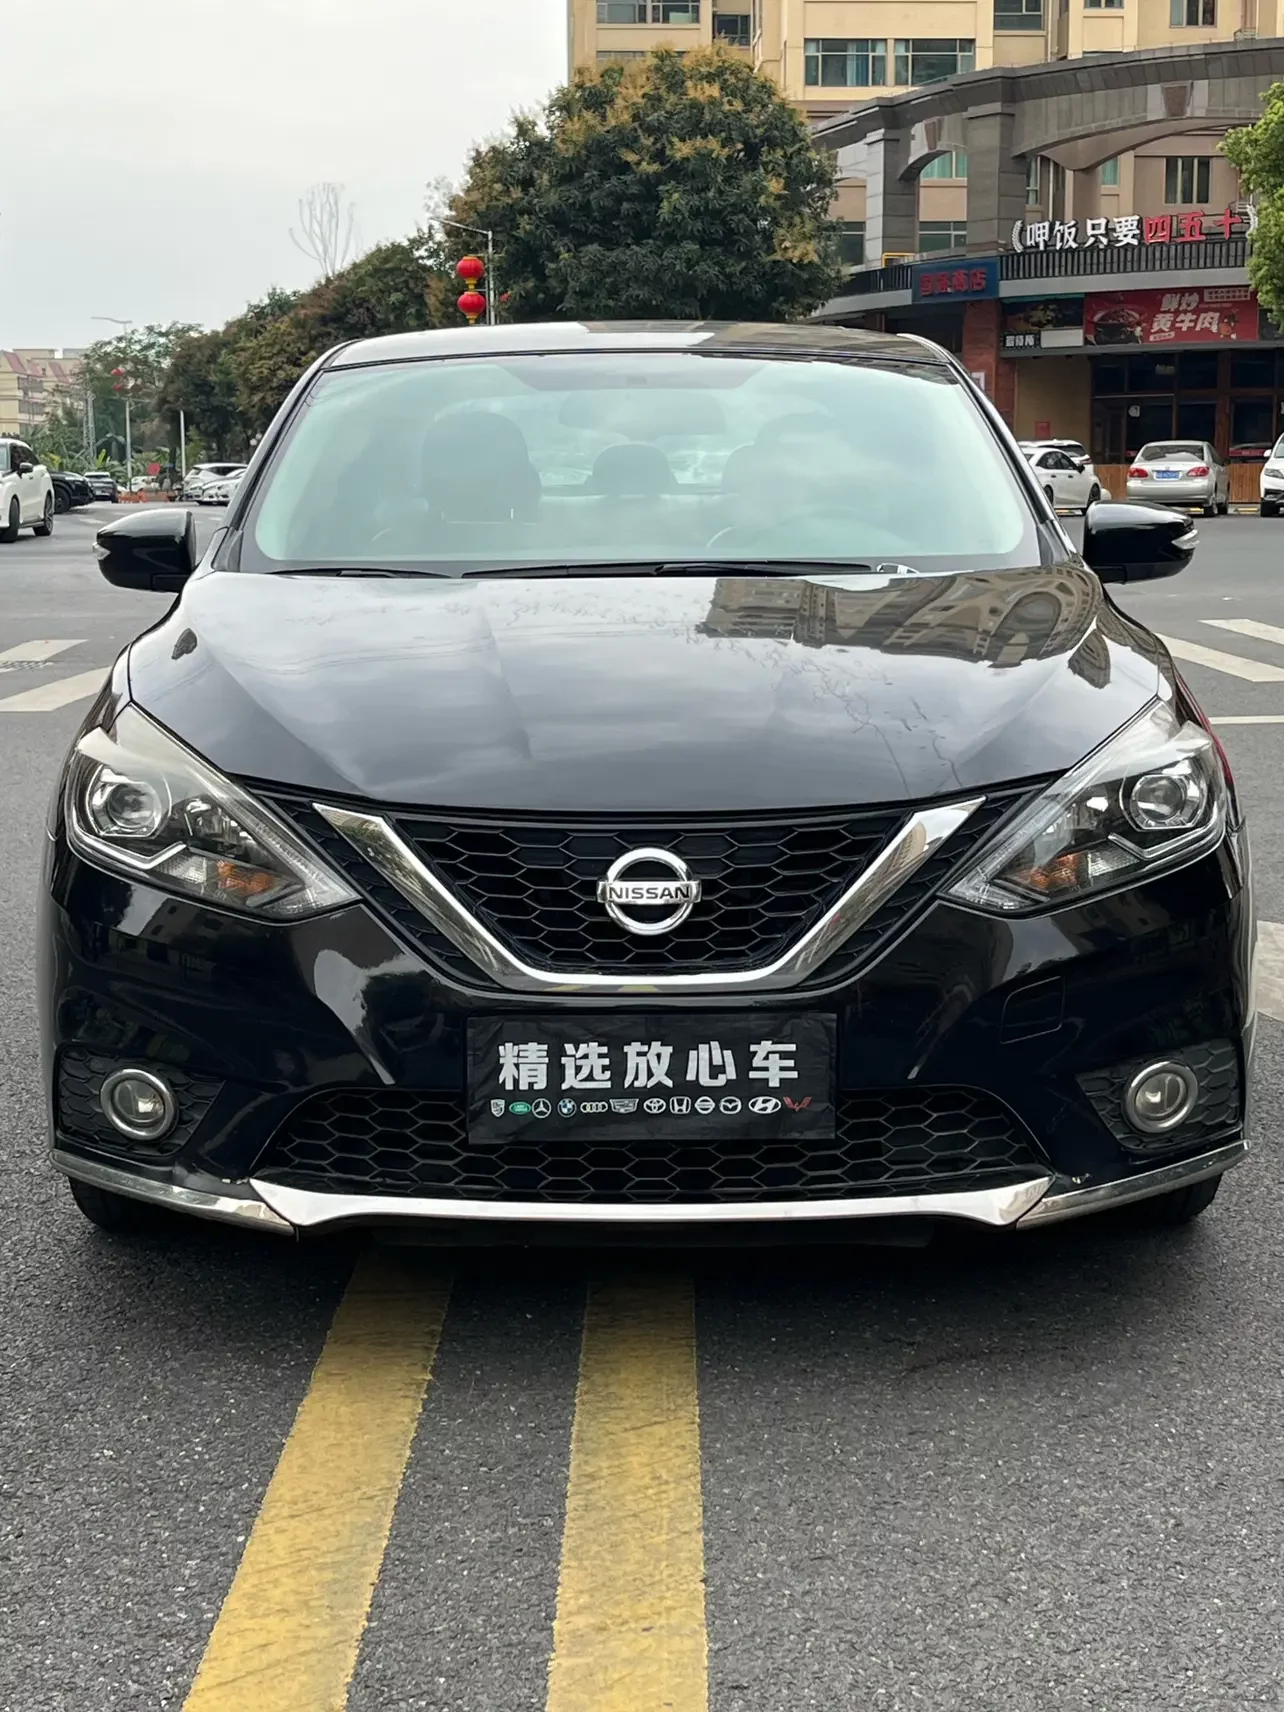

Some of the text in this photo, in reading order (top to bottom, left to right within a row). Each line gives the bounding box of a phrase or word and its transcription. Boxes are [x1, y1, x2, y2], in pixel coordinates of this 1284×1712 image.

[1150, 312, 1220, 332] 黄牛肉
[608, 886, 690, 900] NISSAN
[498, 1041, 798, 1090] 精选放心车
